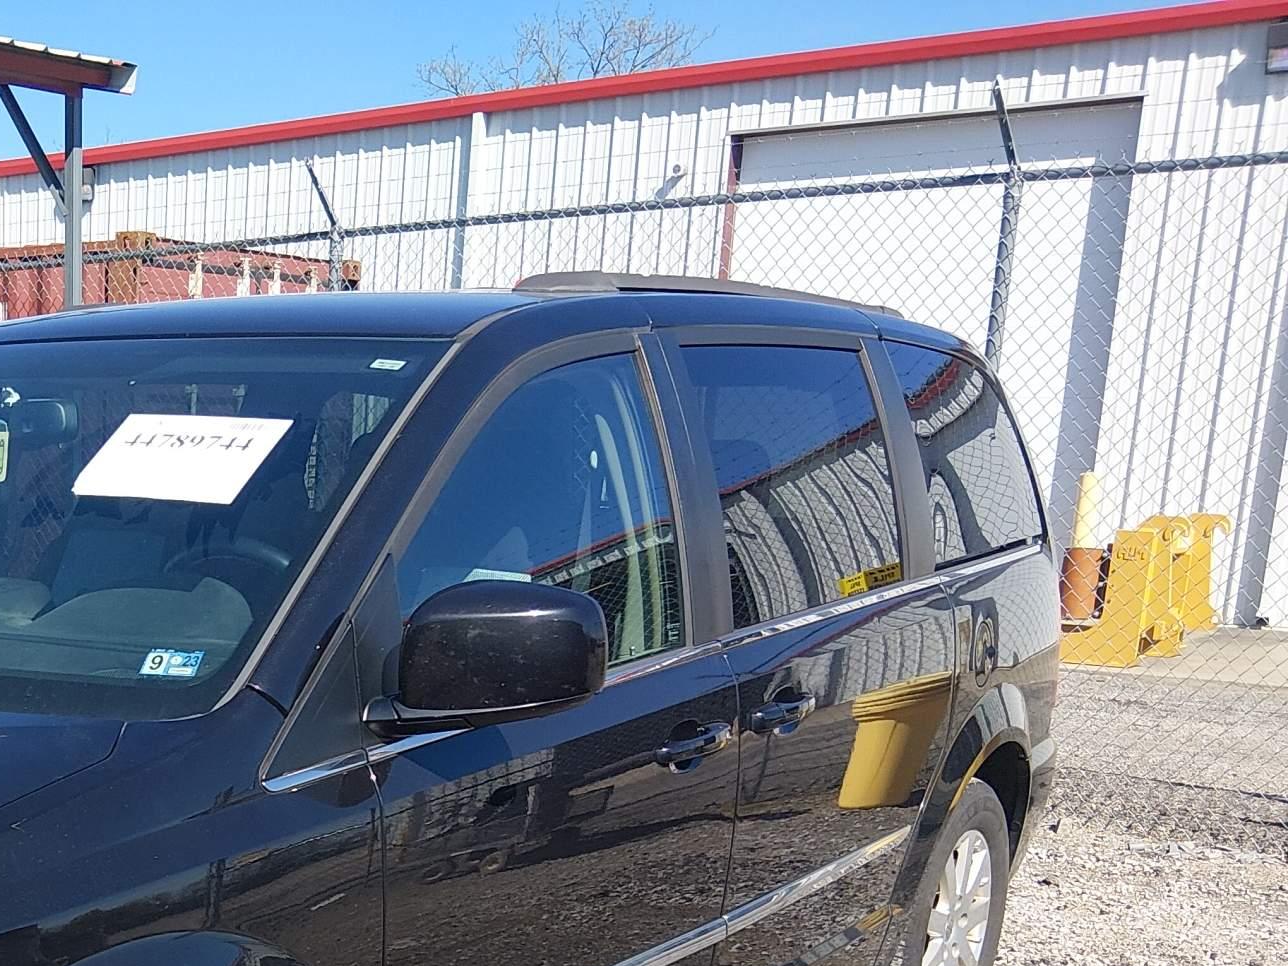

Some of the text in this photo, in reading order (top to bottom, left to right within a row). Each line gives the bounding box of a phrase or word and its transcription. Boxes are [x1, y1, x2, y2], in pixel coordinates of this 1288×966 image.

[124, 433, 253, 451] 44789744
[149, 655, 200, 670] 9 23
